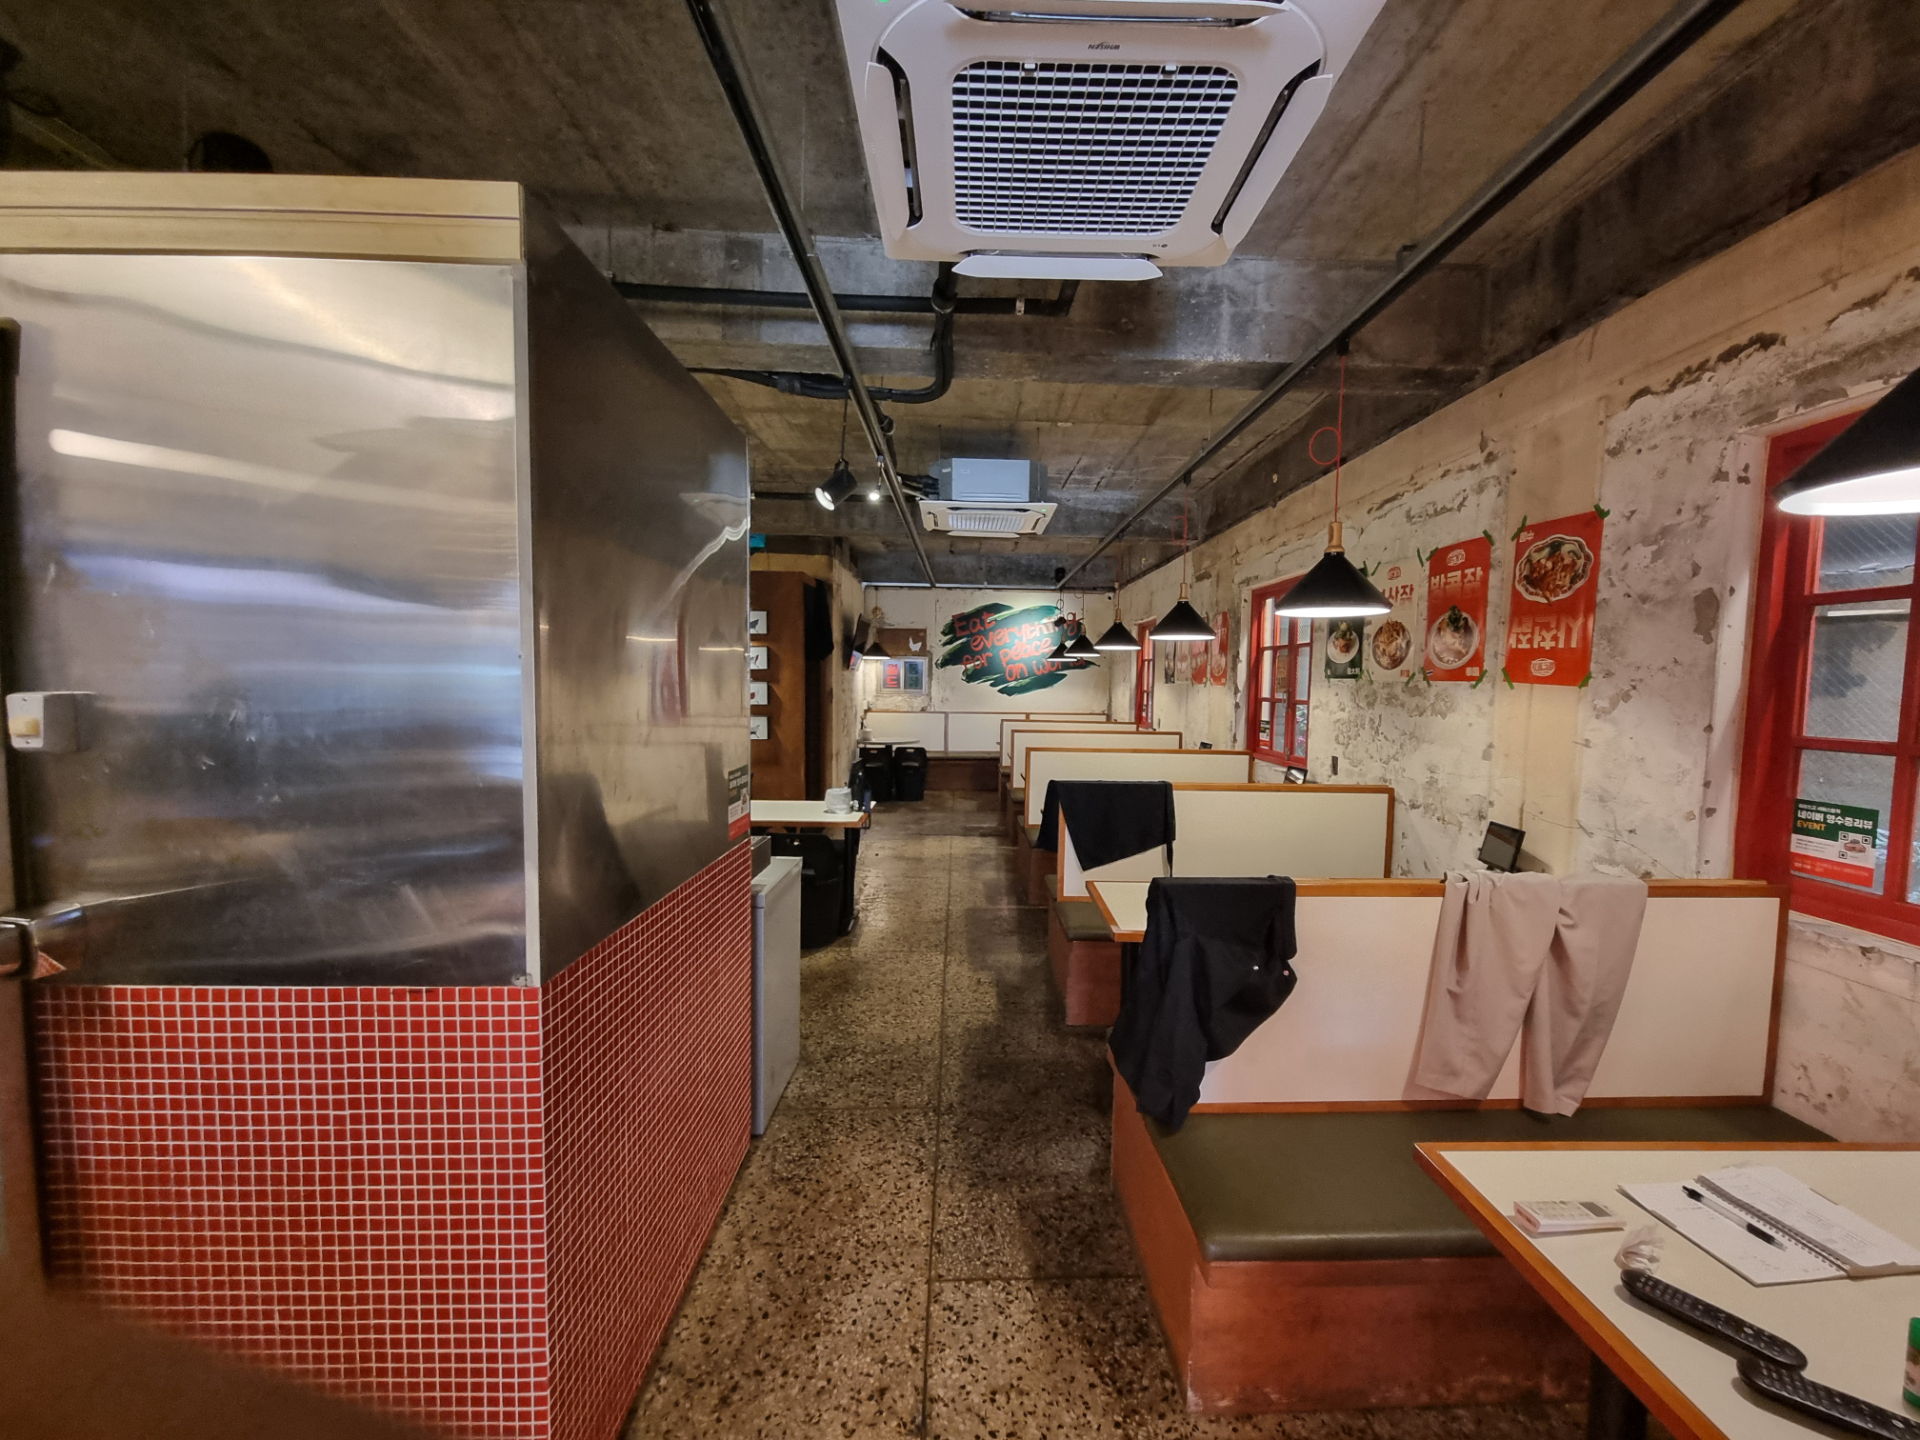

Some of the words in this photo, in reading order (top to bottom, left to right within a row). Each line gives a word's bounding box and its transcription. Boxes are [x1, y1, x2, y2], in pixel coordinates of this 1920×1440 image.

[952, 612, 995, 637] Eat
[961, 651, 993, 670] for
[1001, 637, 1053, 667] peace
[1005, 663, 1028, 682] on
[1797, 810, 1824, 822] 네이버
[1797, 820, 1826, 831] EVENT
